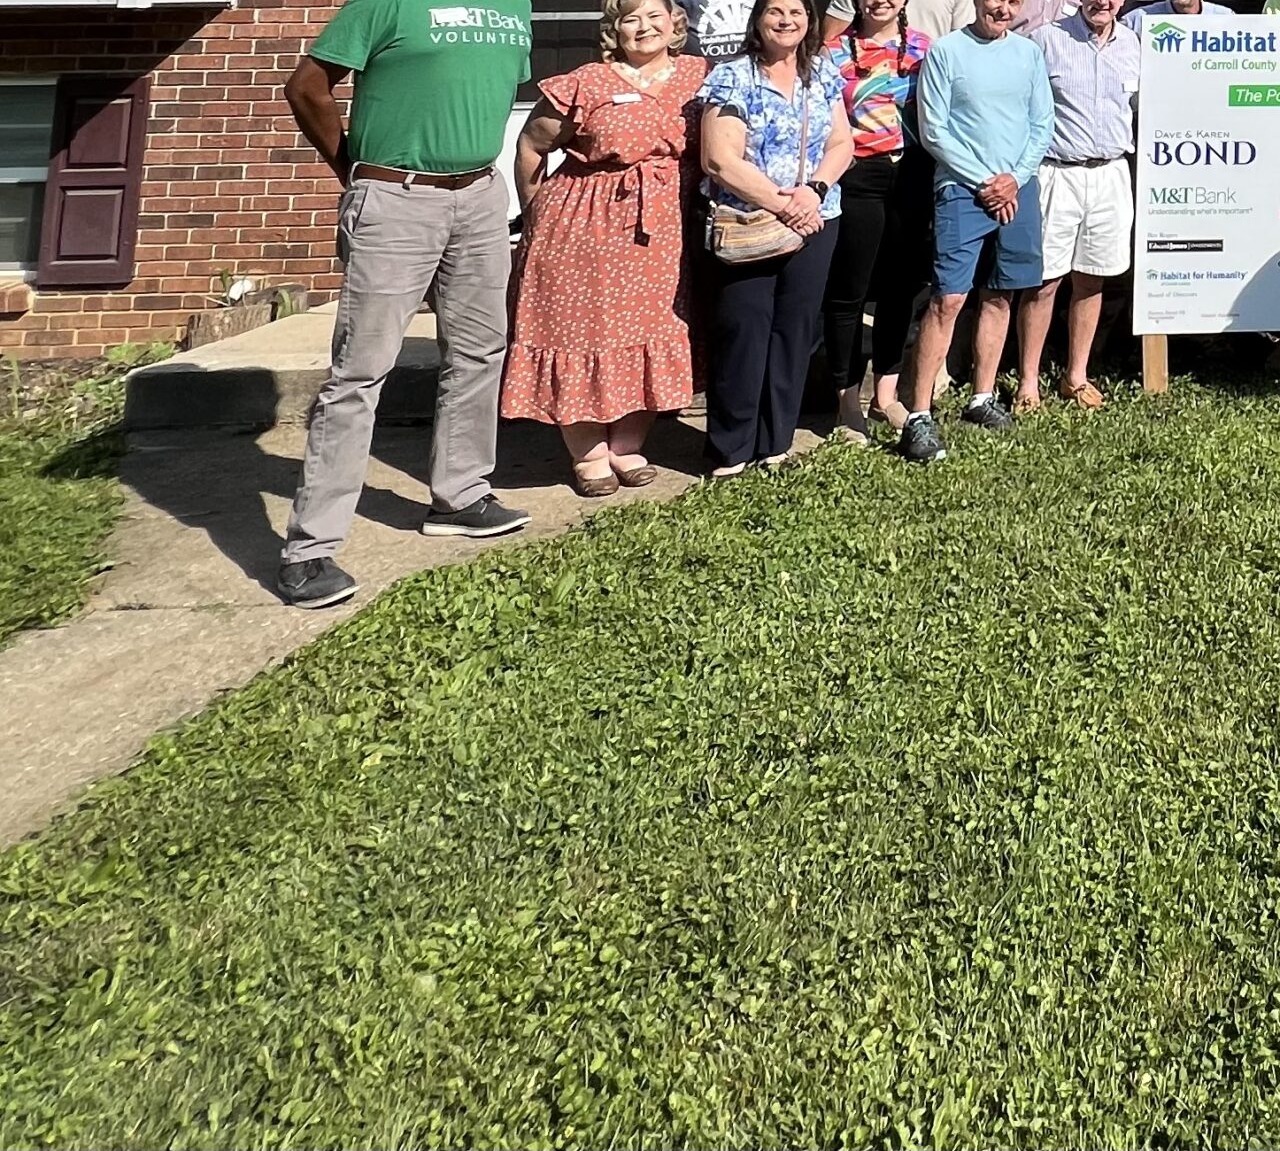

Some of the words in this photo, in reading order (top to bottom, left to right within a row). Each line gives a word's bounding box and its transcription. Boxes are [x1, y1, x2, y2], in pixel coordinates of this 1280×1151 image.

[1192, 30, 1277, 52] Habitat
[700, 43, 741, 56] VOLU
[1191, 58, 1202, 70] of
[1204, 58, 1238, 70] Carroll
[1241, 58, 1277, 72] County
[1236, 89, 1262, 103] The
[1154, 130, 1182, 138] DAVE
[1196, 130, 1230, 138] KAREN
[1147, 140, 1257, 166] BOND
[1149, 187, 1193, 204] M&T
[1195, 186, 1237, 204] Bank
[1160, 271, 1191, 280] Habitat
[1193, 271, 1204, 280] for
